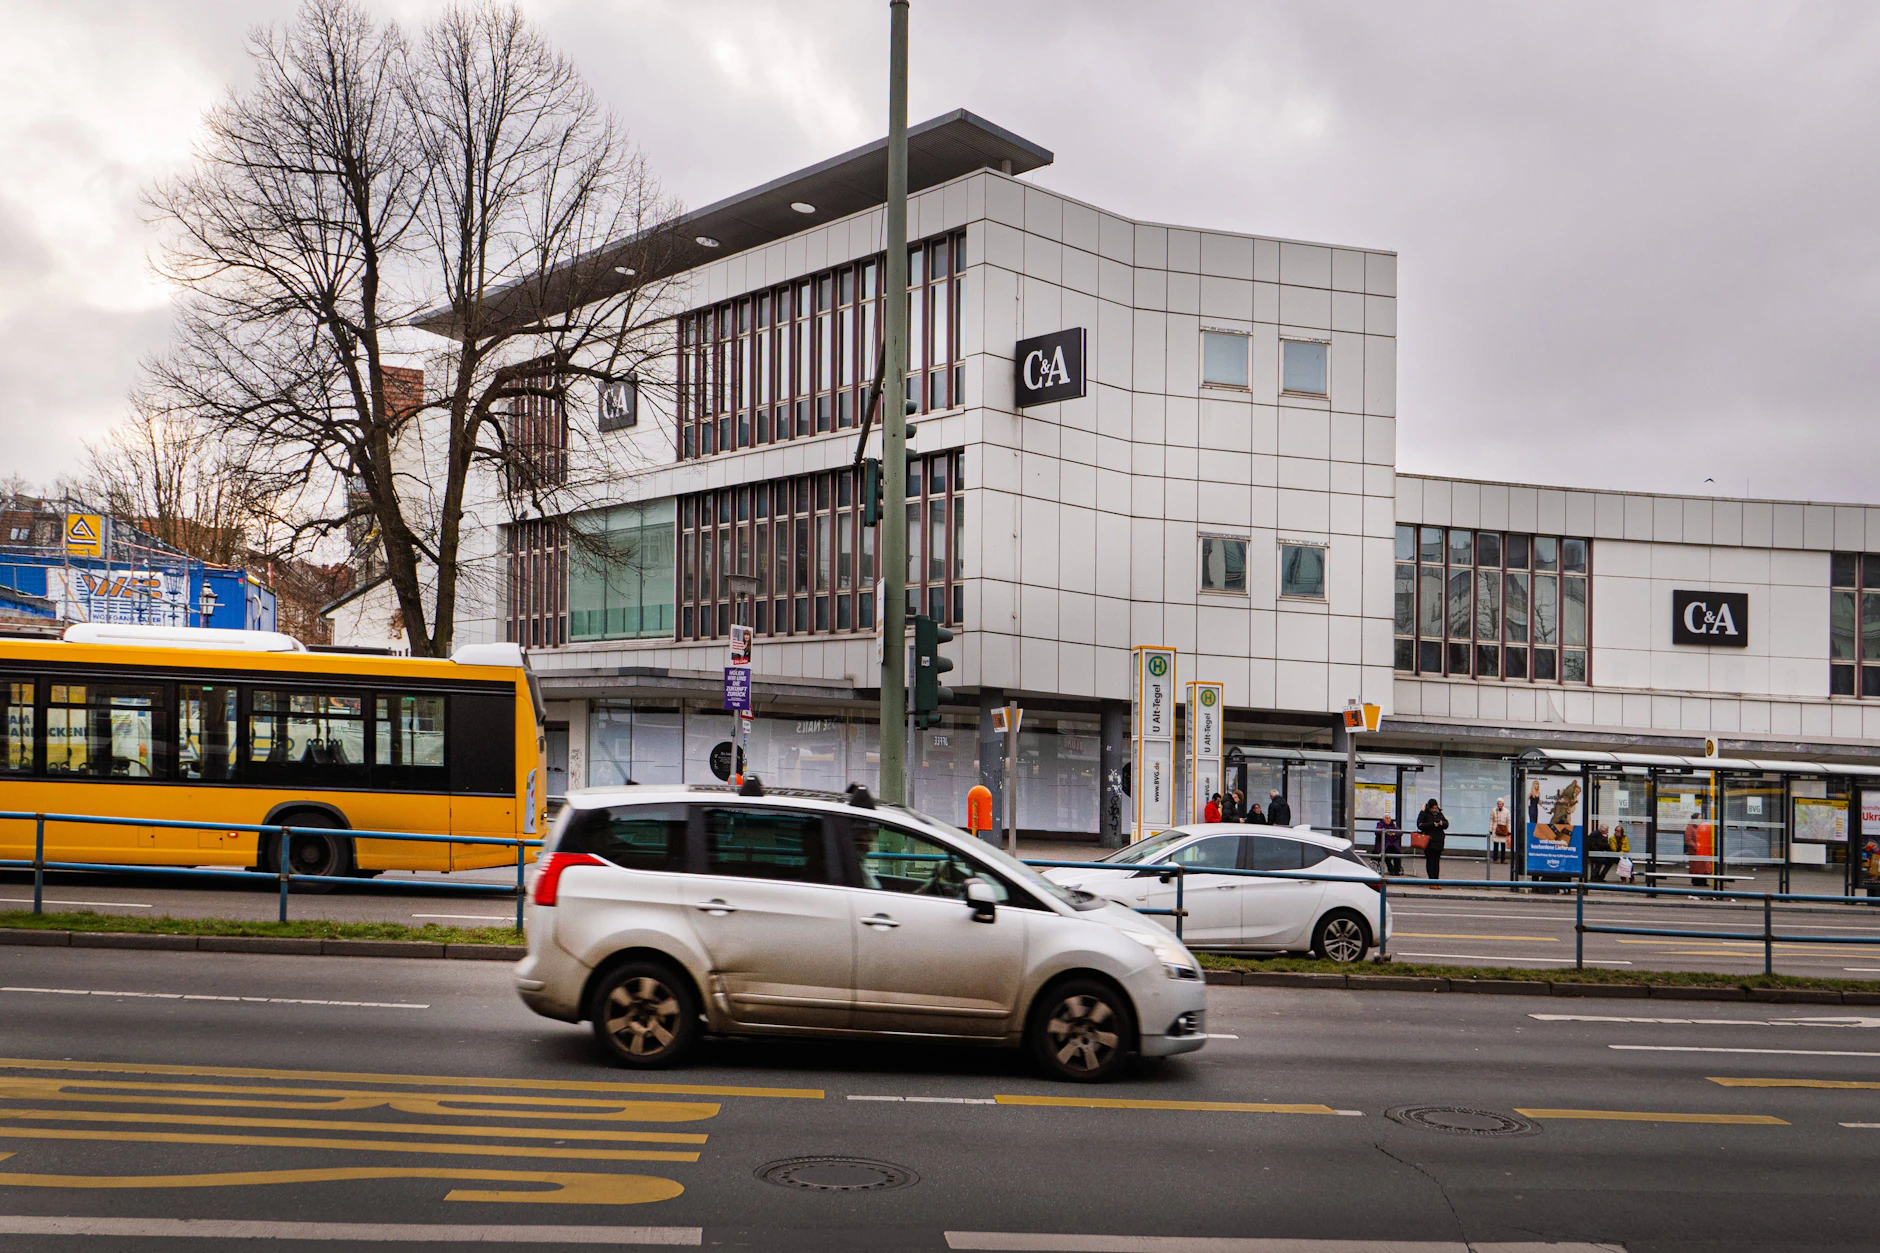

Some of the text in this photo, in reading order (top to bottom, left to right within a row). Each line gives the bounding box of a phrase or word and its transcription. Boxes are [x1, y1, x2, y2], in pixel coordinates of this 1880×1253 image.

[1023, 345, 1071, 390] C&A
[602, 386, 629, 419] C&A
[1683, 601, 1738, 636] C&A
[1152, 684, 1163, 725] Alt-Tegel
[1204, 713, 1213, 746] Alt-Tegel
[1748, 805, 1761, 813] BVG
